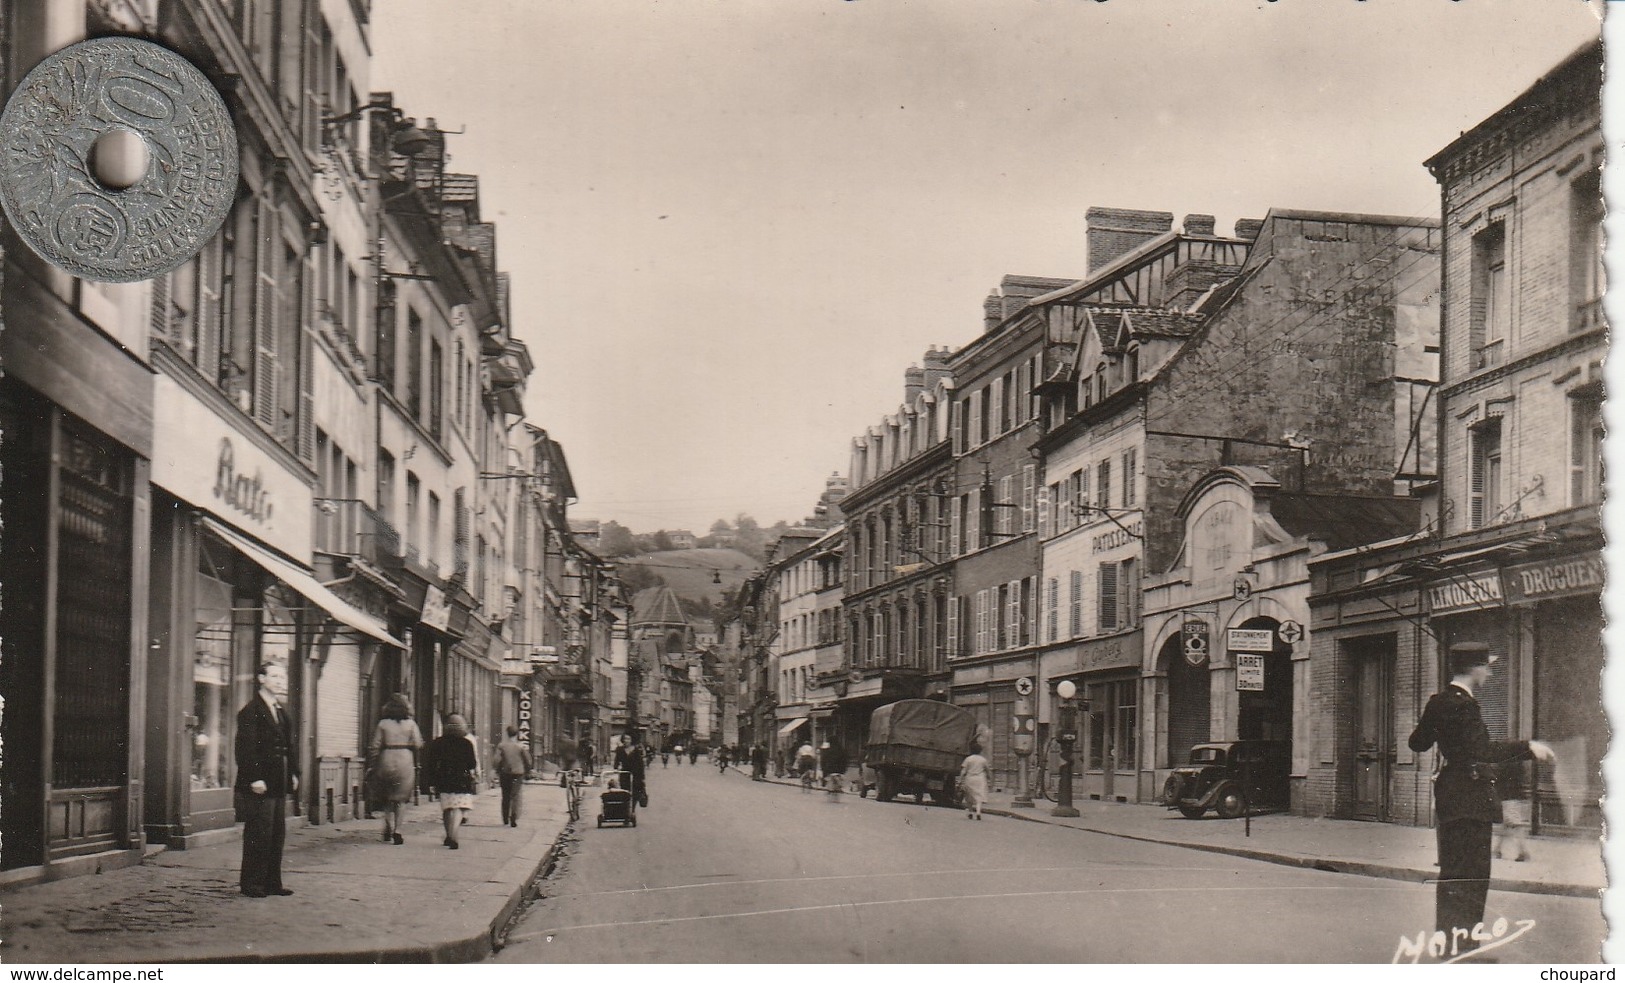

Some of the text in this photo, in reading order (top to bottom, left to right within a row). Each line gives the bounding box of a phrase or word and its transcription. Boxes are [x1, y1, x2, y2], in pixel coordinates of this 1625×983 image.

[101, 55, 185, 127] 10
[1091, 520, 1143, 555] PATISSERIE
[1429, 576, 1502, 609] LINOLEUM
[1231, 630, 1270, 639] STATIONNEMENT
[1239, 656, 1263, 668] ARRET
